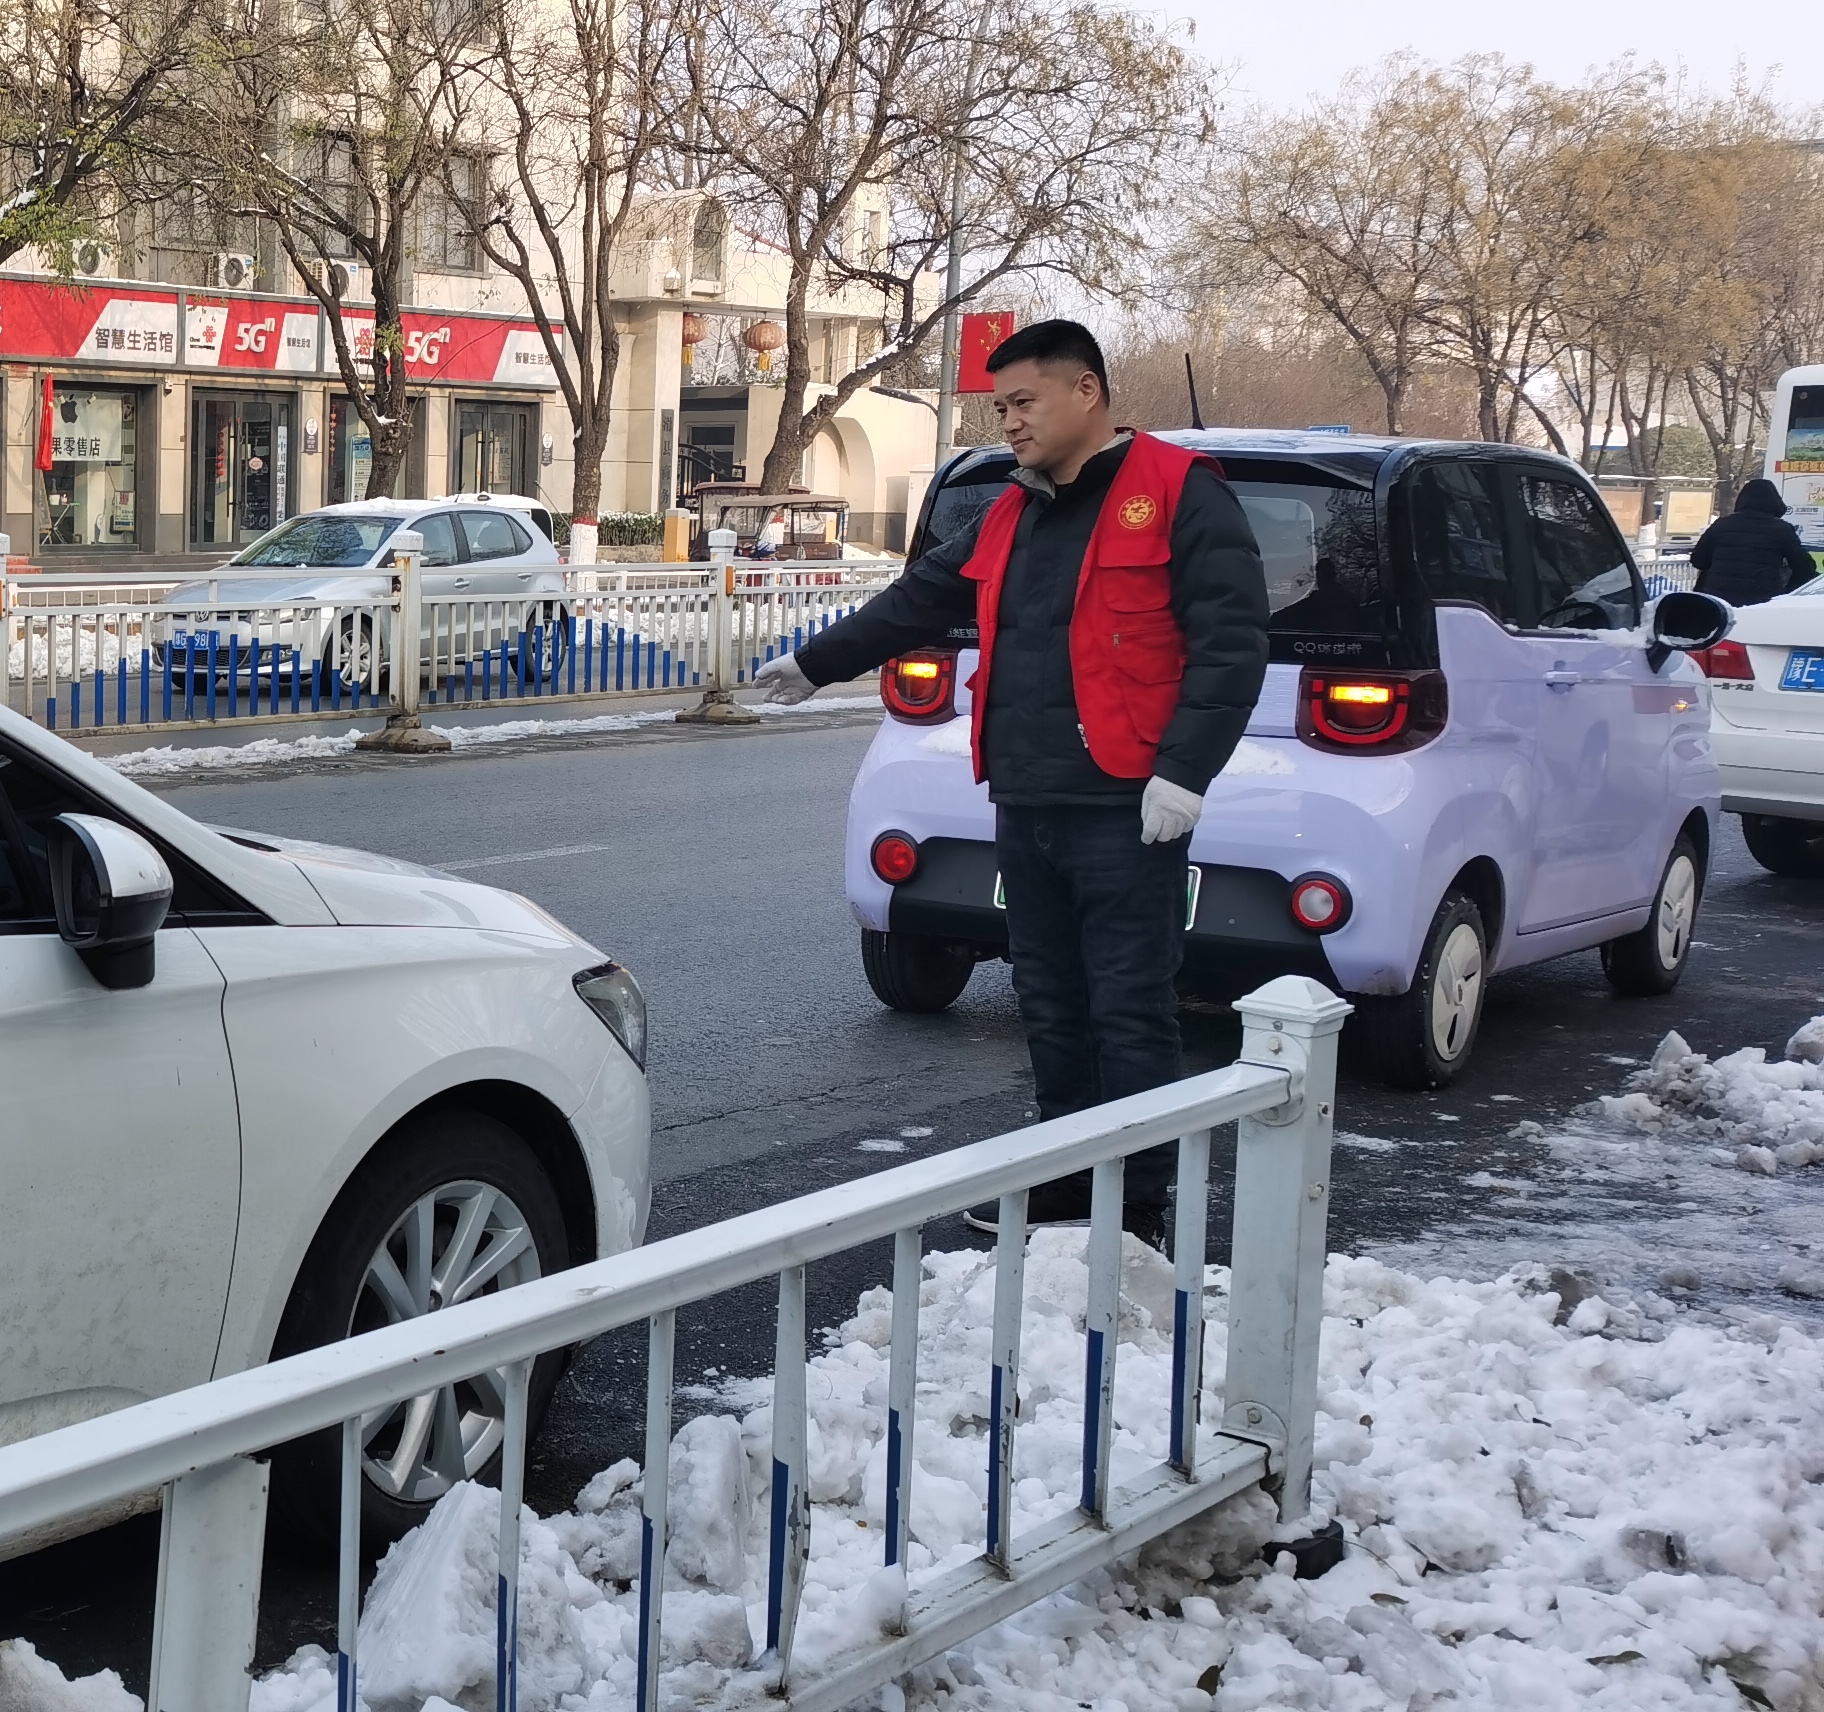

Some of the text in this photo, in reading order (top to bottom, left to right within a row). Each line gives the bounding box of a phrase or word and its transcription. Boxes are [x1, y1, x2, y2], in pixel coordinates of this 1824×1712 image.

[95, 327, 174, 353] 智慧生活馆
[52, 436, 101, 458] 果零售店
